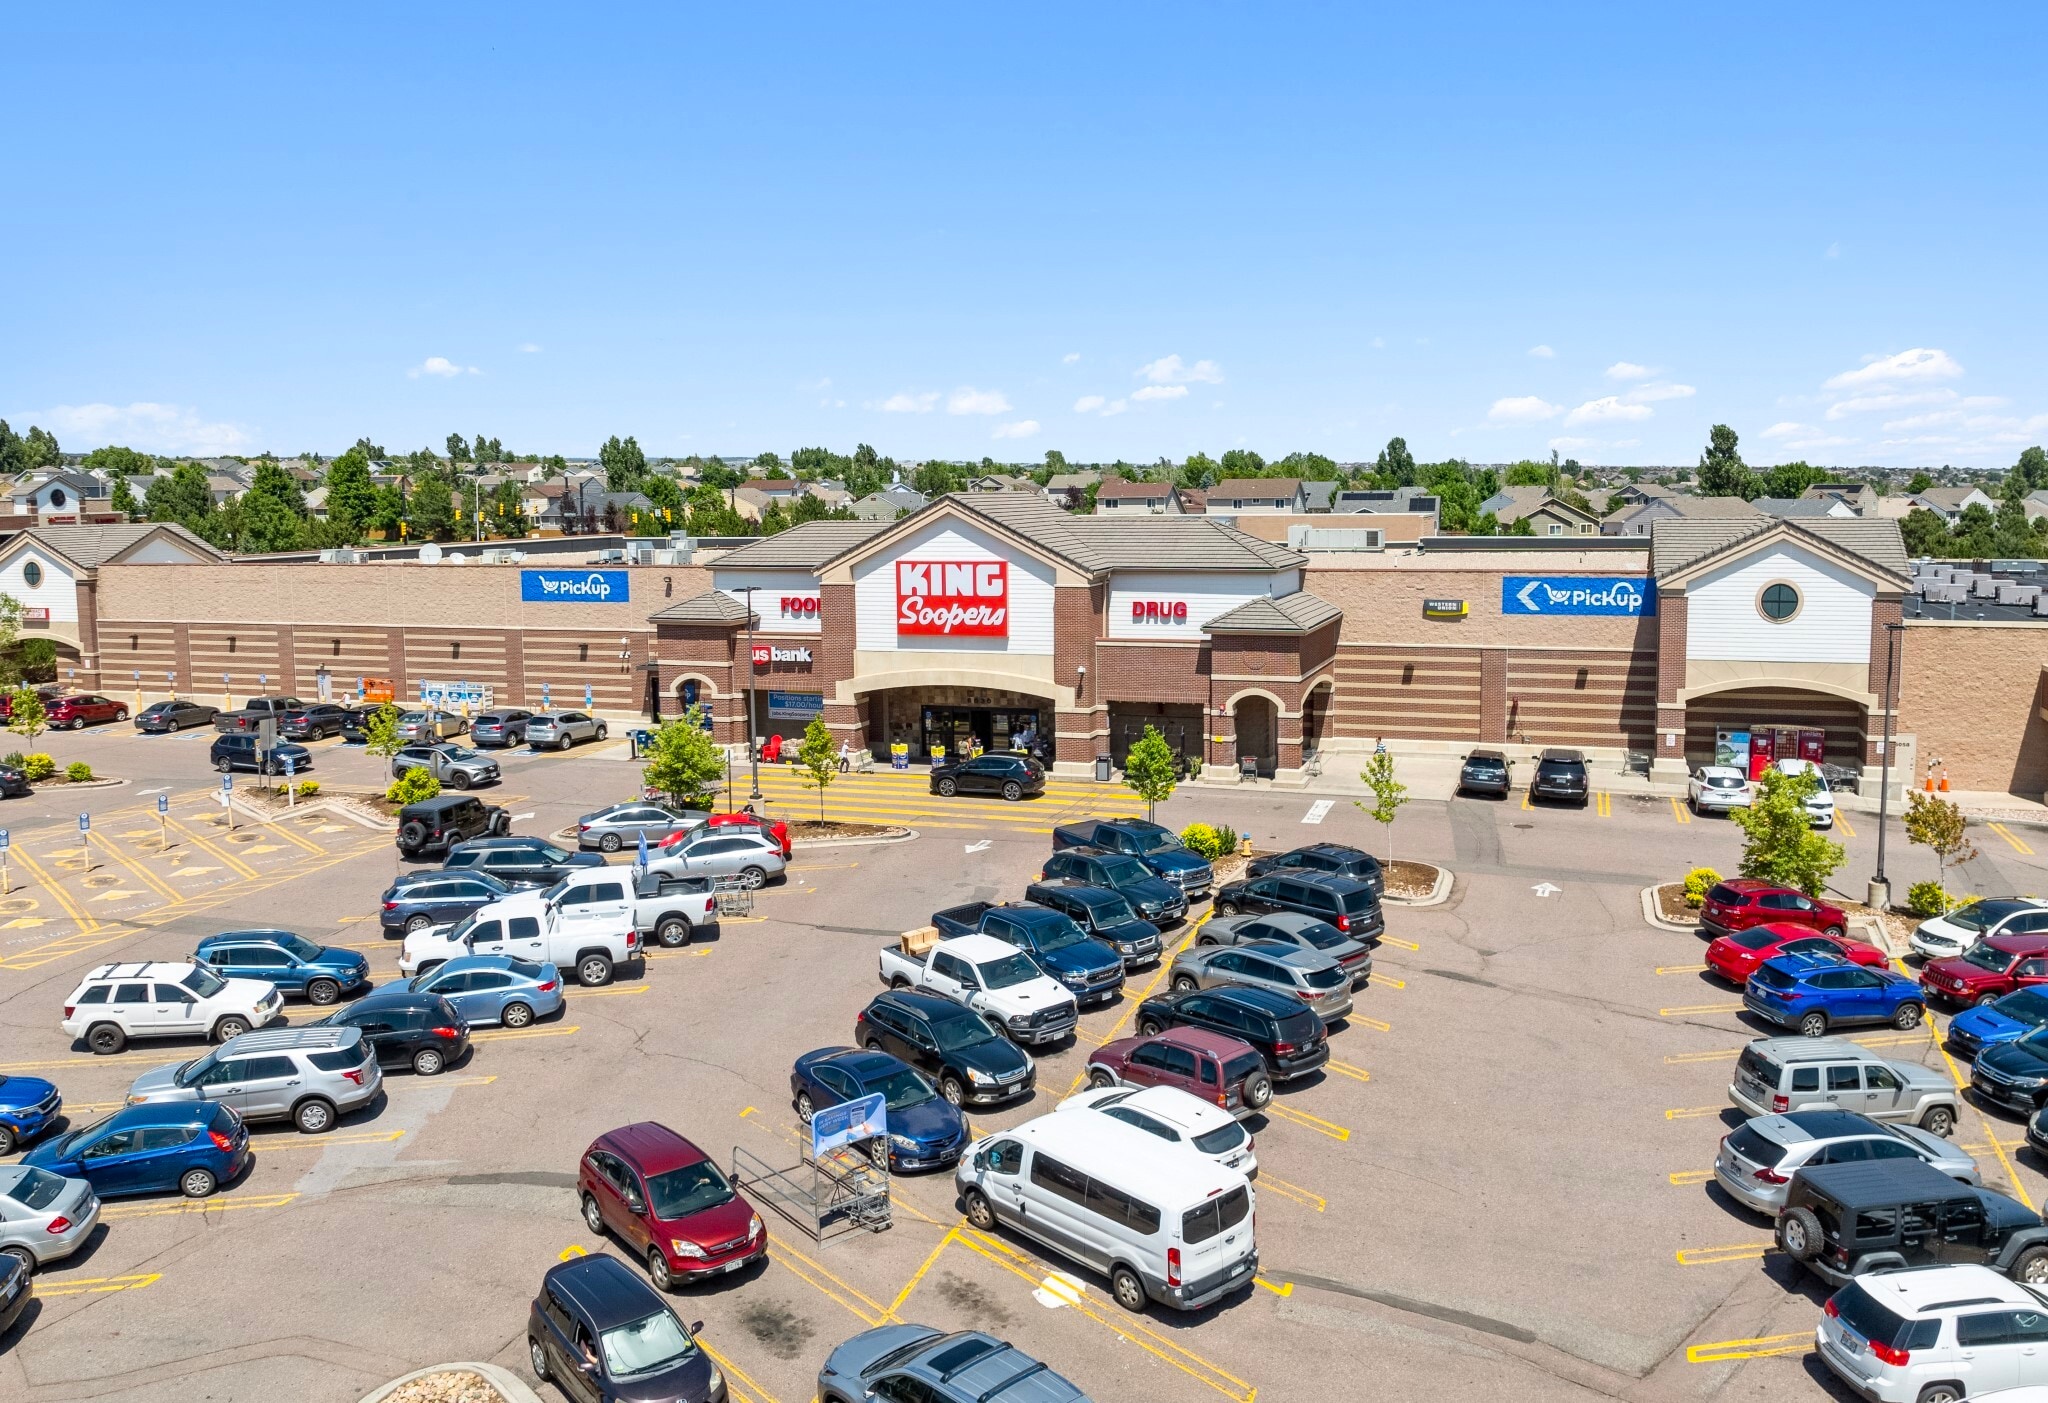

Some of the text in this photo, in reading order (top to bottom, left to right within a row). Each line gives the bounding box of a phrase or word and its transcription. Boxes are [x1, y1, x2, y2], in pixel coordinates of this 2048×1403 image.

[900, 563, 1004, 596] KING
[898, 596, 1007, 634] Soopers
[1132, 601, 1187, 618] DRUG
